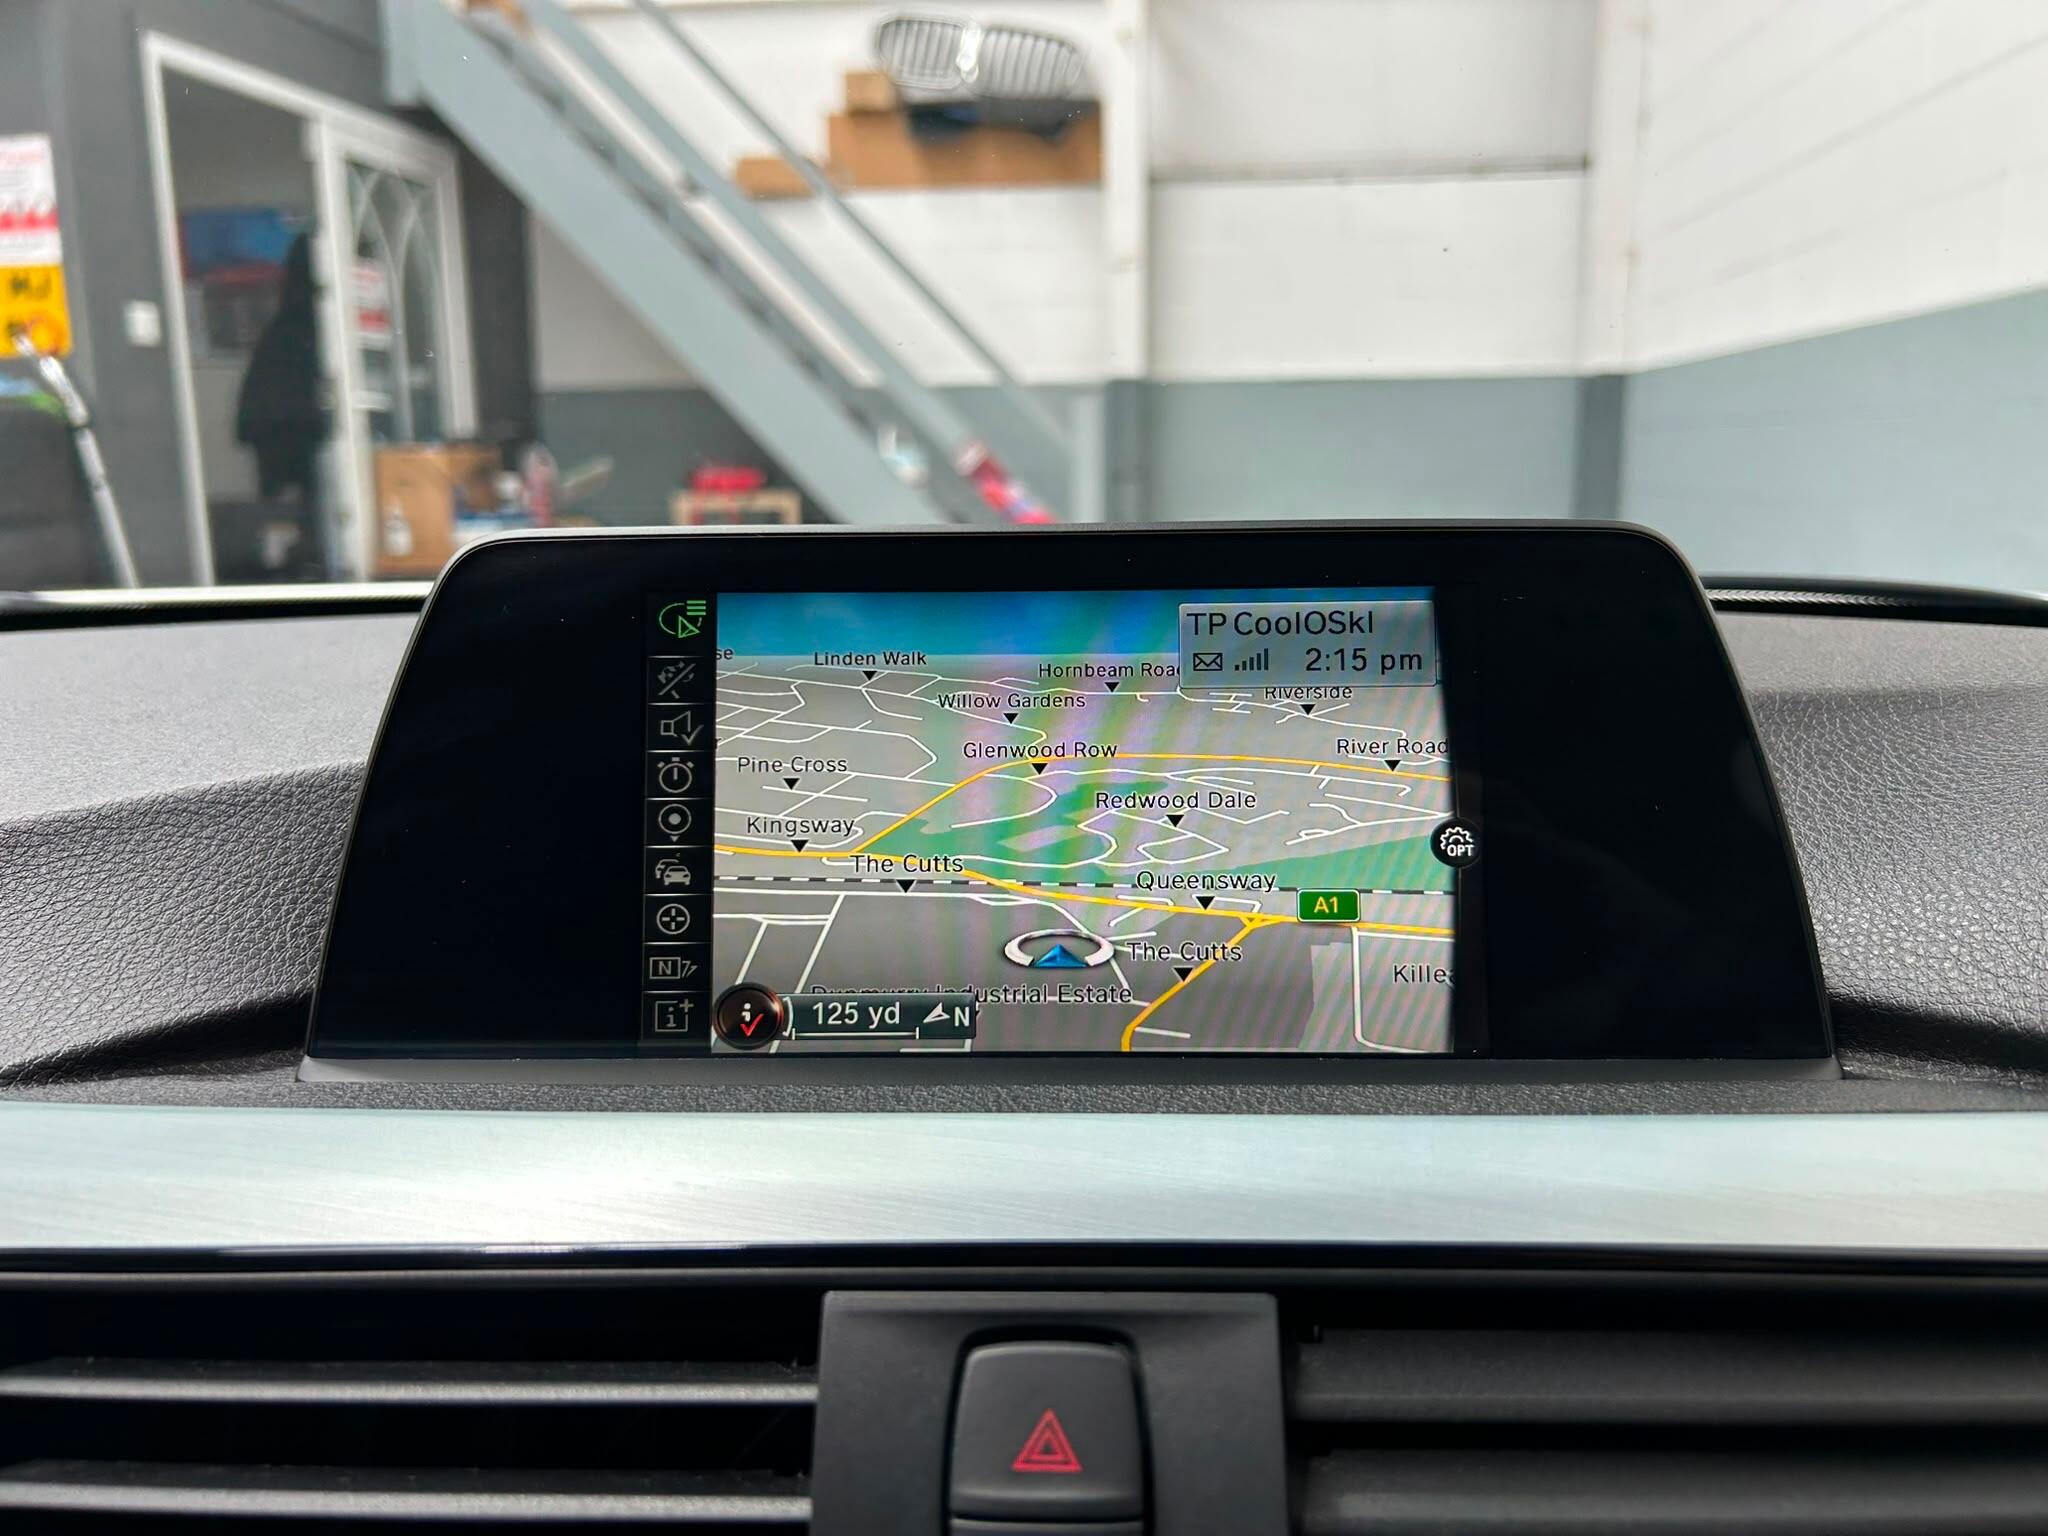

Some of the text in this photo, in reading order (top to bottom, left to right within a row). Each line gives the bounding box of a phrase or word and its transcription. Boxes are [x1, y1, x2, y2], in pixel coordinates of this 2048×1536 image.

[1186, 612, 1227, 636] TP
[814, 650, 927, 666] Linden Walk
[1305, 648, 1422, 675] 2:15 pm
[1039, 662, 1134, 677] Hornbeam
[938, 693, 1086, 708] Willow Gardens
[1265, 686, 1353, 699] Riverside
[963, 741, 1118, 758] Glenwood Row
[1337, 738, 1449, 754] River Road
[738, 756, 848, 773] Pine Cross
[1096, 791, 1256, 809] Redwood Dale
[746, 816, 855, 837] Kingsway
[1446, 844, 1475, 857] OPT
[850, 854, 964, 873] The Cutts
[1136, 870, 1276, 892] Queensway
[1313, 897, 1339, 914] A1
[1126, 942, 1242, 962] The Cutts
[1058, 984, 1132, 1004] Estate
[812, 1001, 900, 1029] 125 yd
[953, 1006, 970, 1027] N
